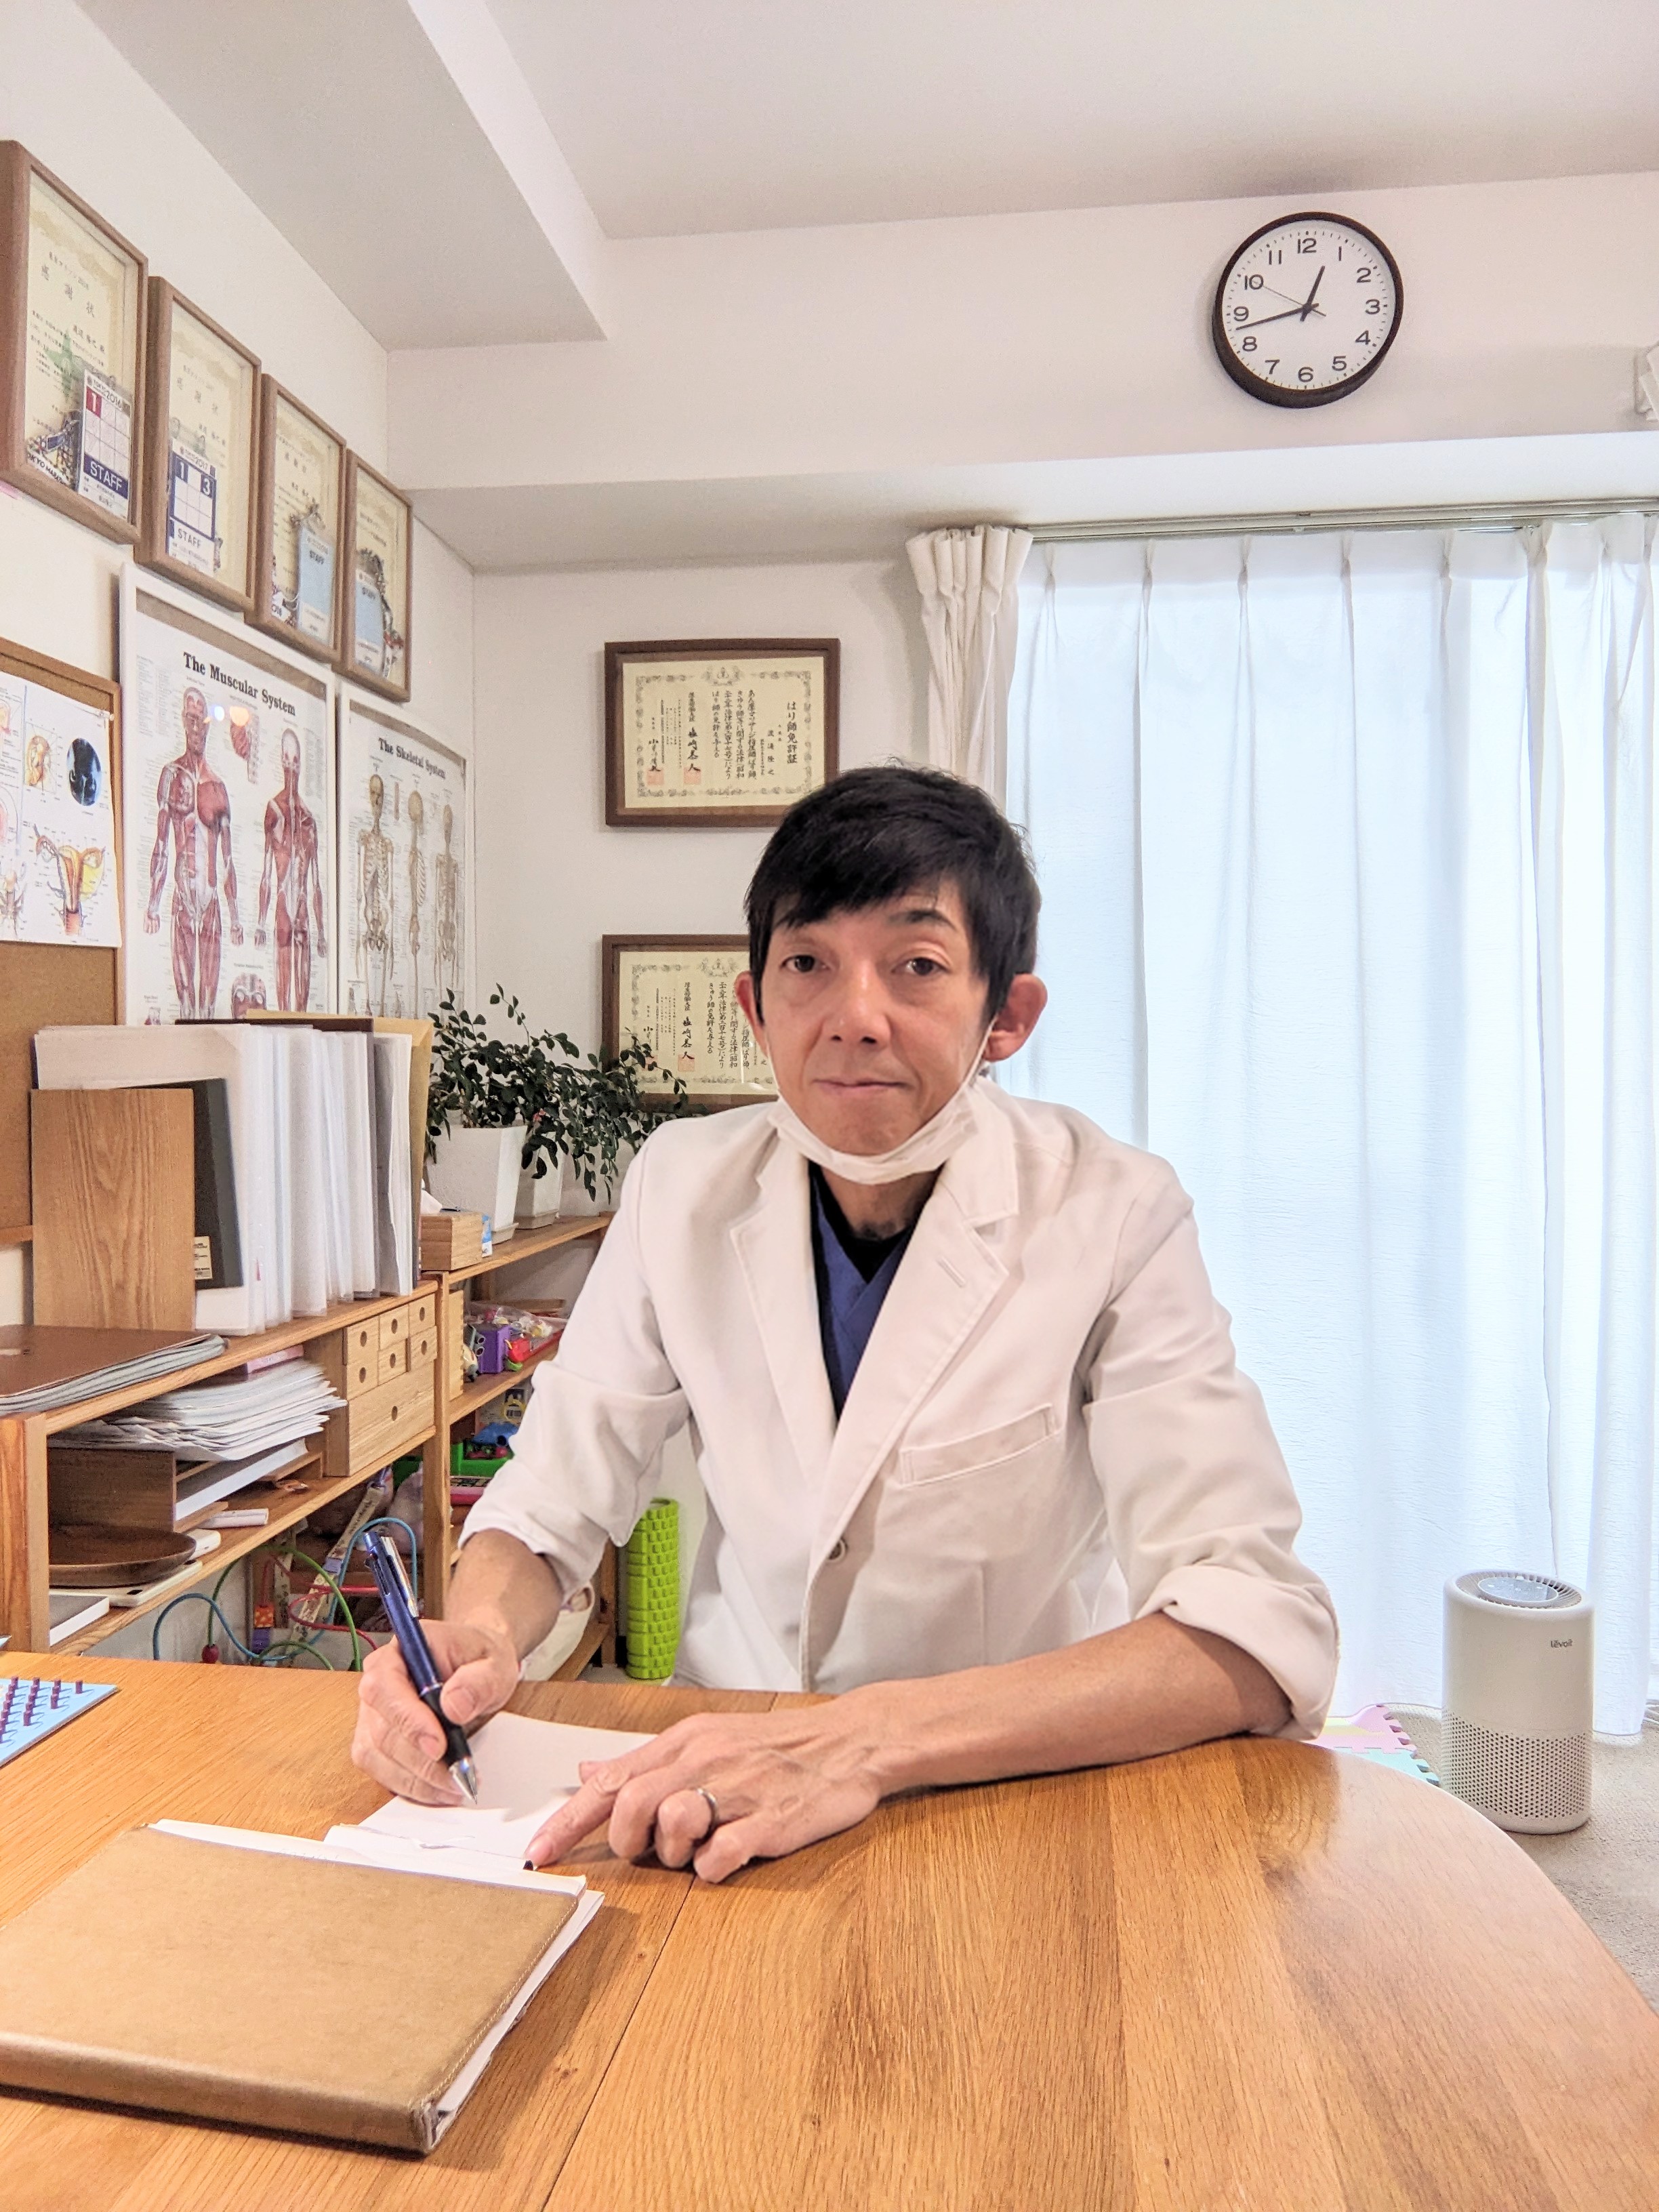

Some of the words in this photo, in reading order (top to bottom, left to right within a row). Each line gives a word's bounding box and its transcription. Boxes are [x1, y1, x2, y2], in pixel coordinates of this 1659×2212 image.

[1297, 237, 1317, 254] 12
[1338, 245, 1343, 262] 1
[1268, 249, 1283, 265] 11
[1244, 274, 1264, 291] 10
[1356, 267, 1372, 283] 2
[1233, 306, 1249, 322] 9
[1365, 299, 1380, 315] 3
[1242, 336, 1258, 352] 8
[1355, 330, 1370, 346] 4
[1265, 359, 1280, 375] 7
[1332, 355, 1347, 371] 5
[1298, 367, 1314, 382] 6
[91, 391, 97, 412] 1
[90, 460, 123, 491] STAFF
[179, 462, 184, 479] 1
[202, 476, 211, 495] 3
[178, 528, 201, 549] STAFF
[183, 651, 206, 676] The
[209, 663, 259, 699] Muscular
[262, 689, 296, 716] System
[786, 701, 798, 764] はり師免許証
[379, 737, 394, 755] The
[396, 745, 424, 769] Skeletal
[425, 759, 446, 779] System
